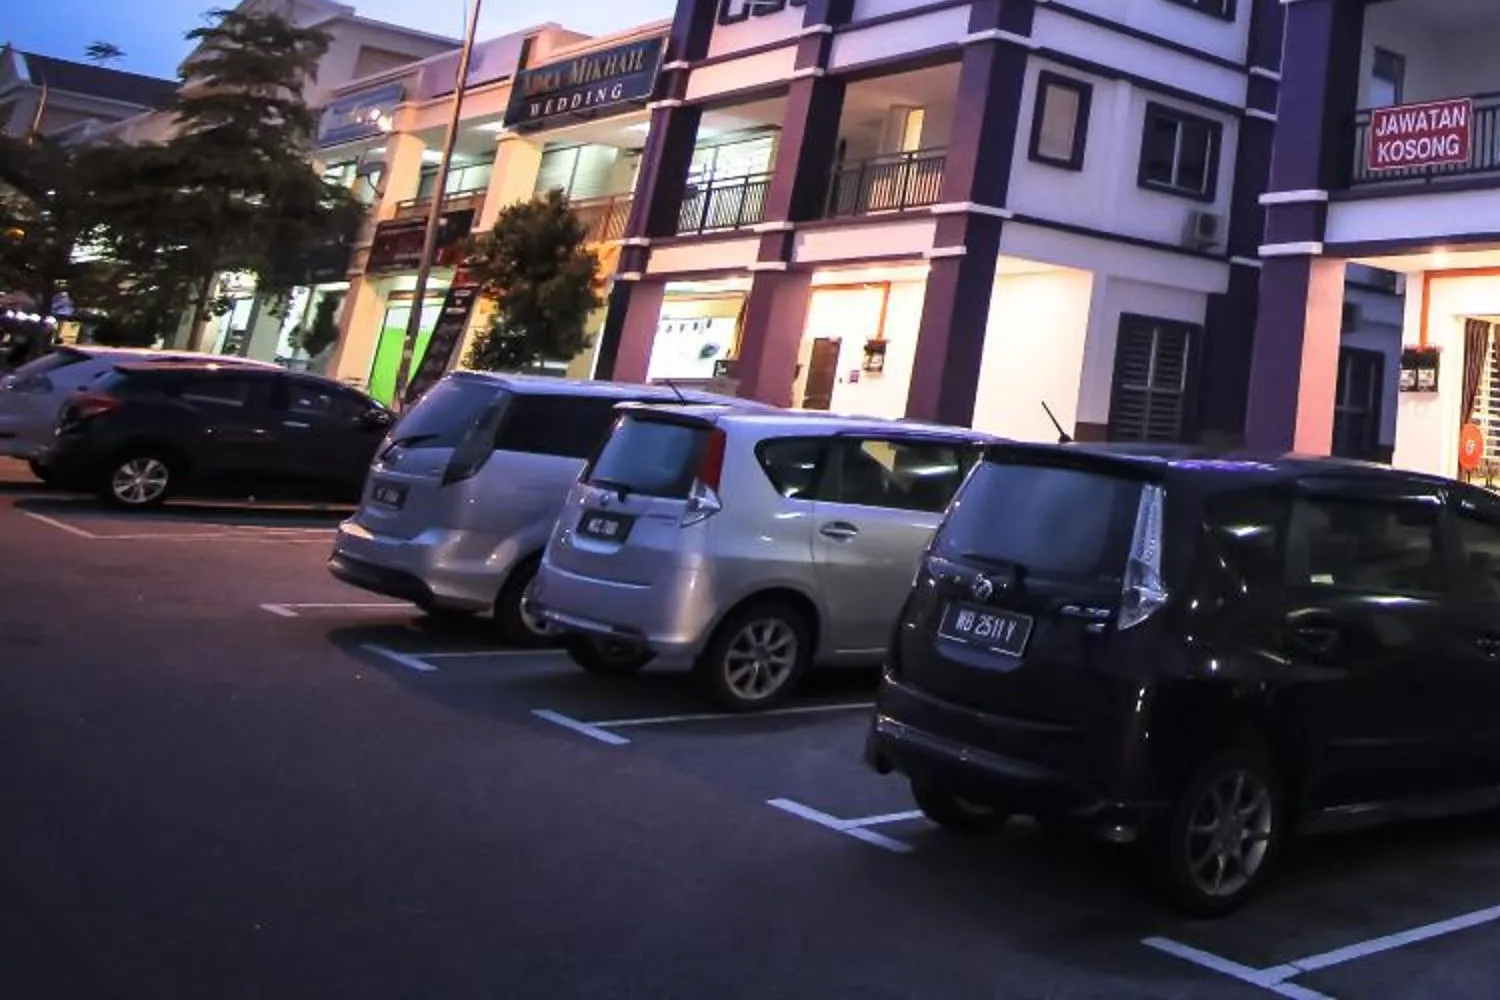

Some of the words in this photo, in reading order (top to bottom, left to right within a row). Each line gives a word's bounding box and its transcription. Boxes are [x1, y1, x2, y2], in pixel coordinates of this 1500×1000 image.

[529, 83, 624, 117] WEDDING
[1375, 105, 1466, 136] JAWATAN
[1377, 134, 1460, 163] KOSONG
